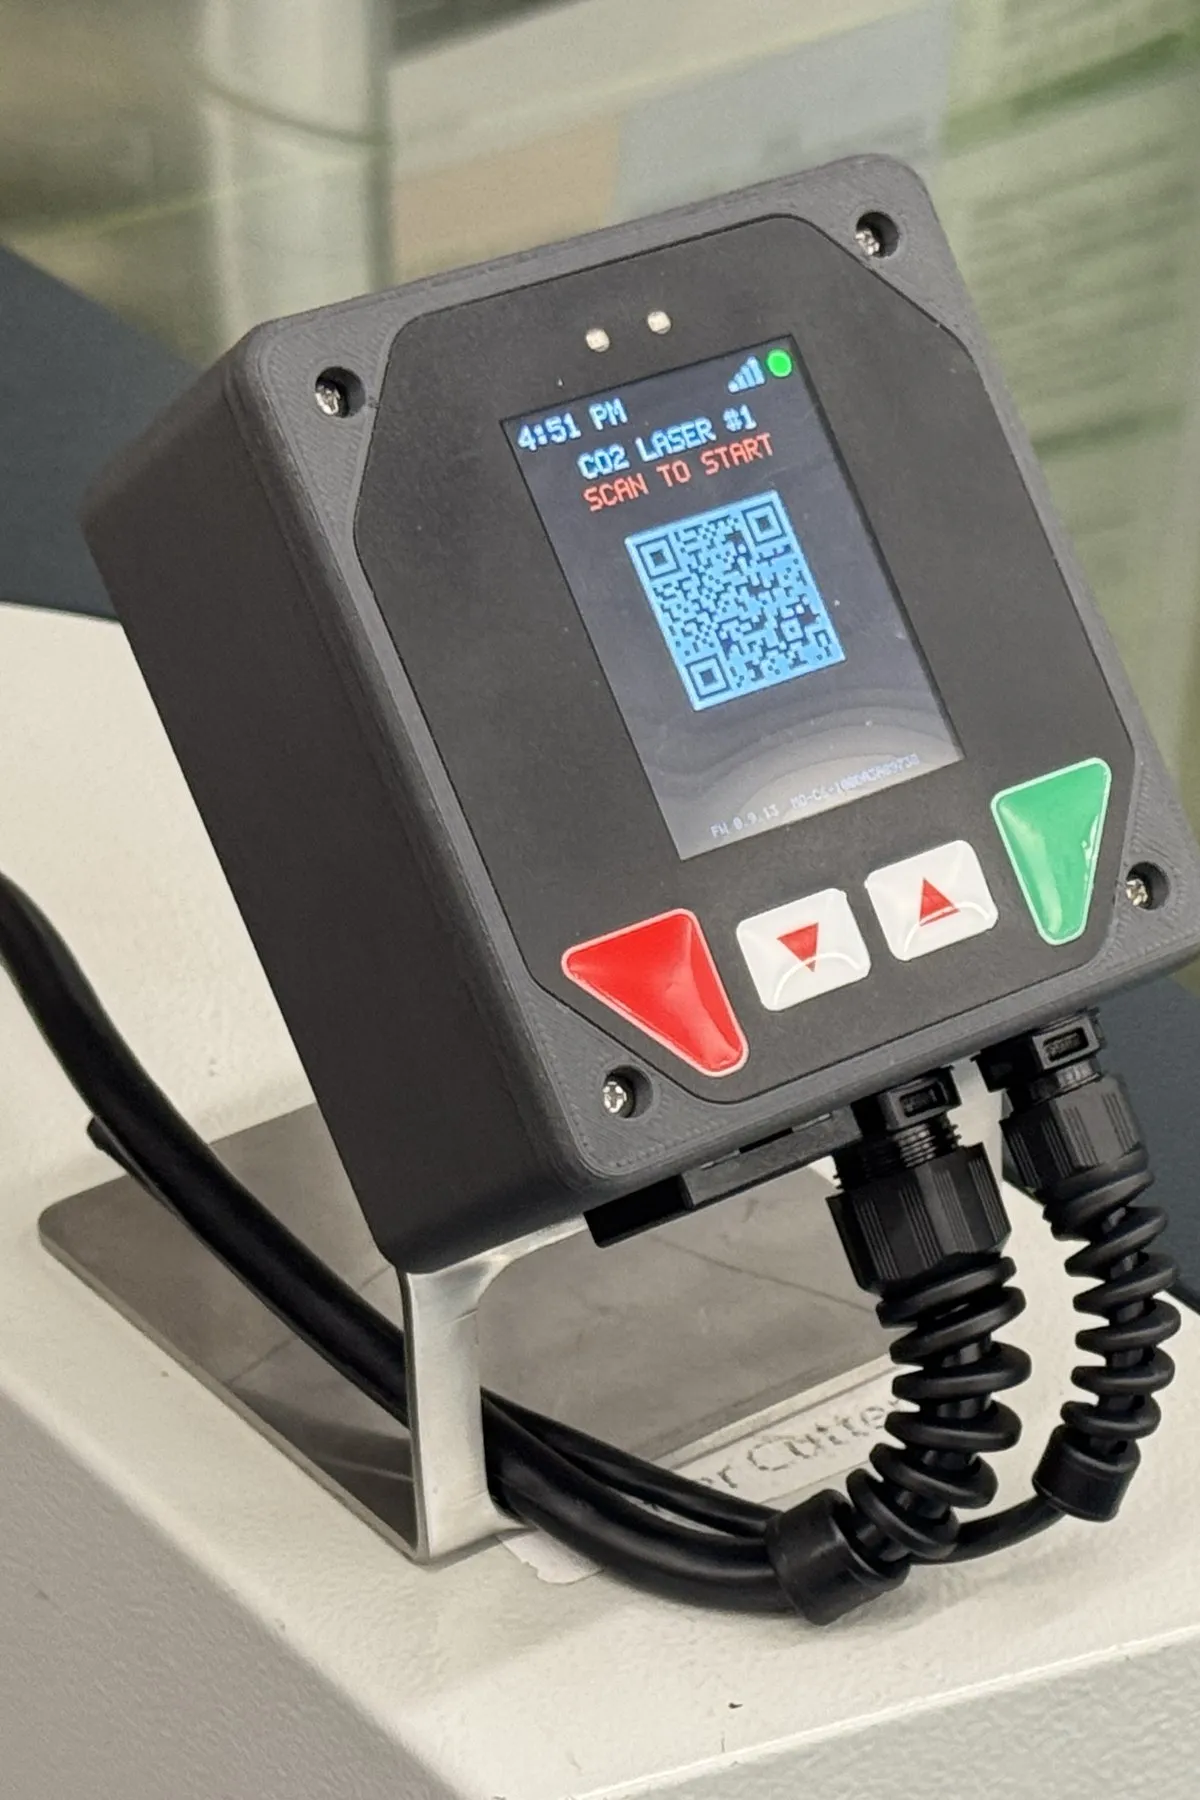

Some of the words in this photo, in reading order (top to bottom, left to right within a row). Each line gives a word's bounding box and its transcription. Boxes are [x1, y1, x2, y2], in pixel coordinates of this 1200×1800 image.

[517, 412, 582, 451] 4:51
[588, 397, 629, 431] PM
[634, 416, 717, 463] LASER
[722, 403, 757, 433] #1
[582, 471, 650, 512] SCAN
[655, 459, 692, 488] TO
[700, 432, 774, 476] START
